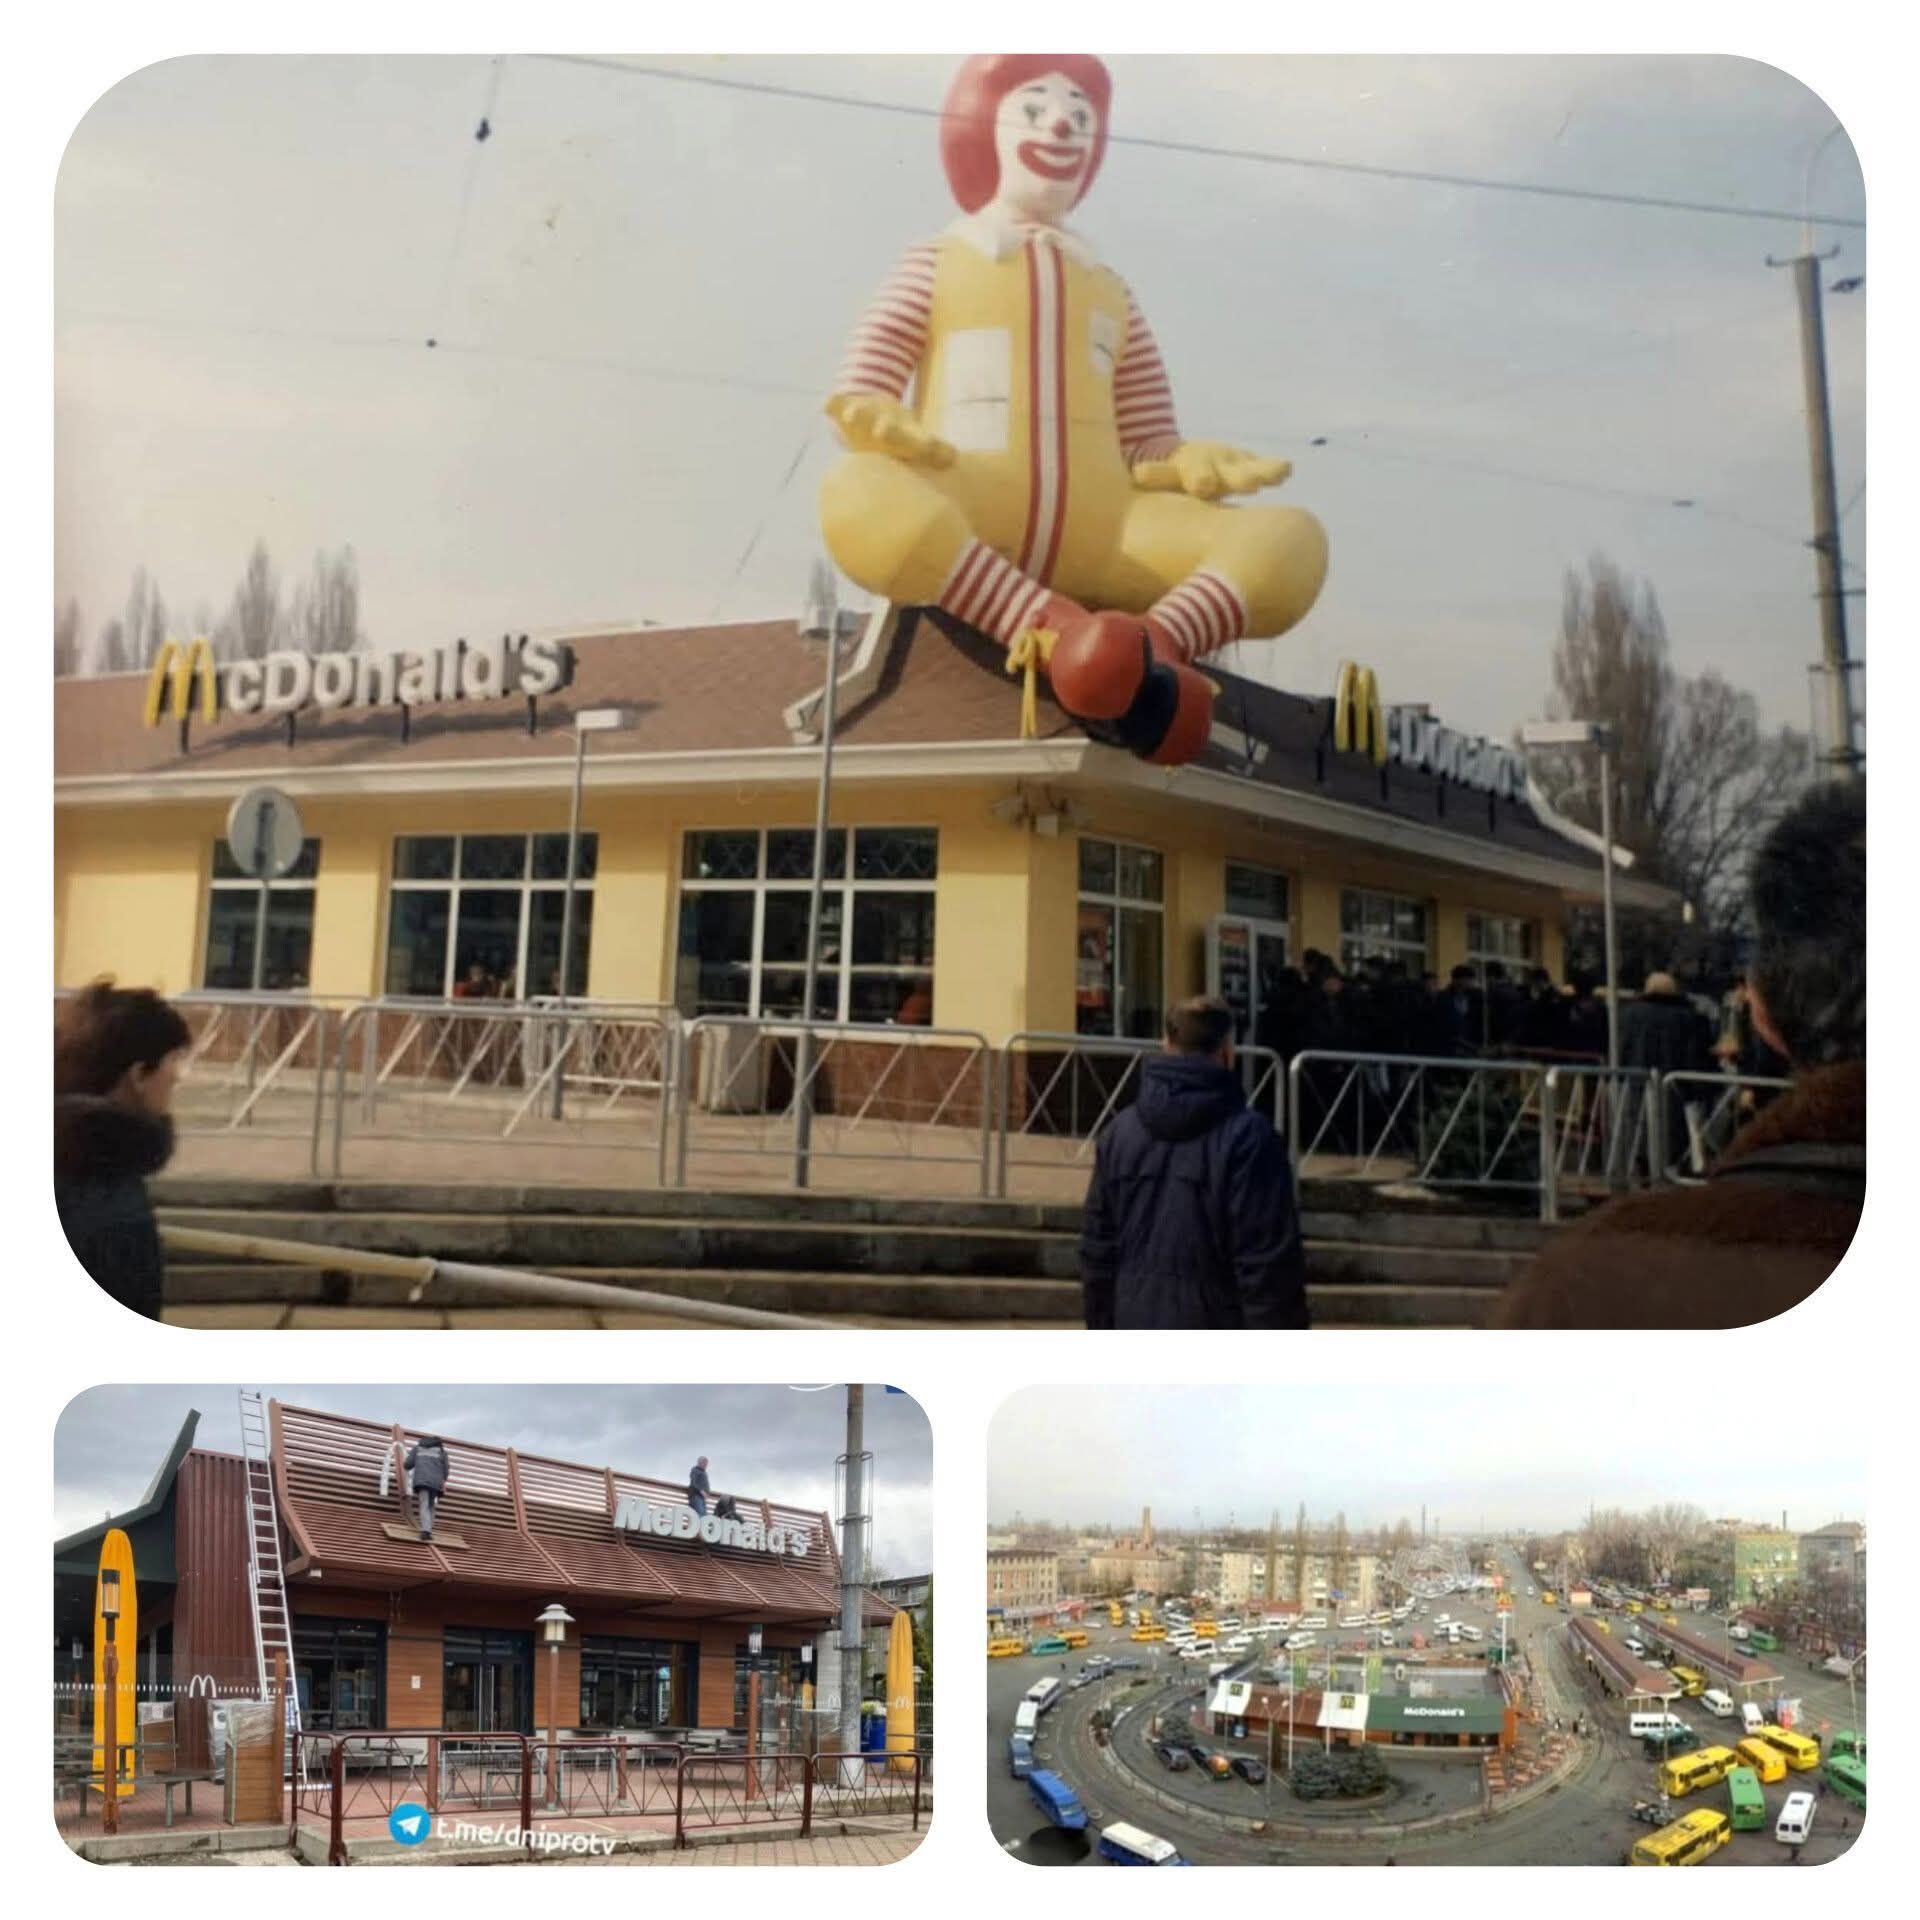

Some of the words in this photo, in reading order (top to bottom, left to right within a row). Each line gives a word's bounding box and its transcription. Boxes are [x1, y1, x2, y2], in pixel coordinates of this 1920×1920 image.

[145, 635, 570, 728] McDonald's
[614, 1495, 810, 1556] McDonald's
[1404, 1706, 1465, 1717] McDonald's
